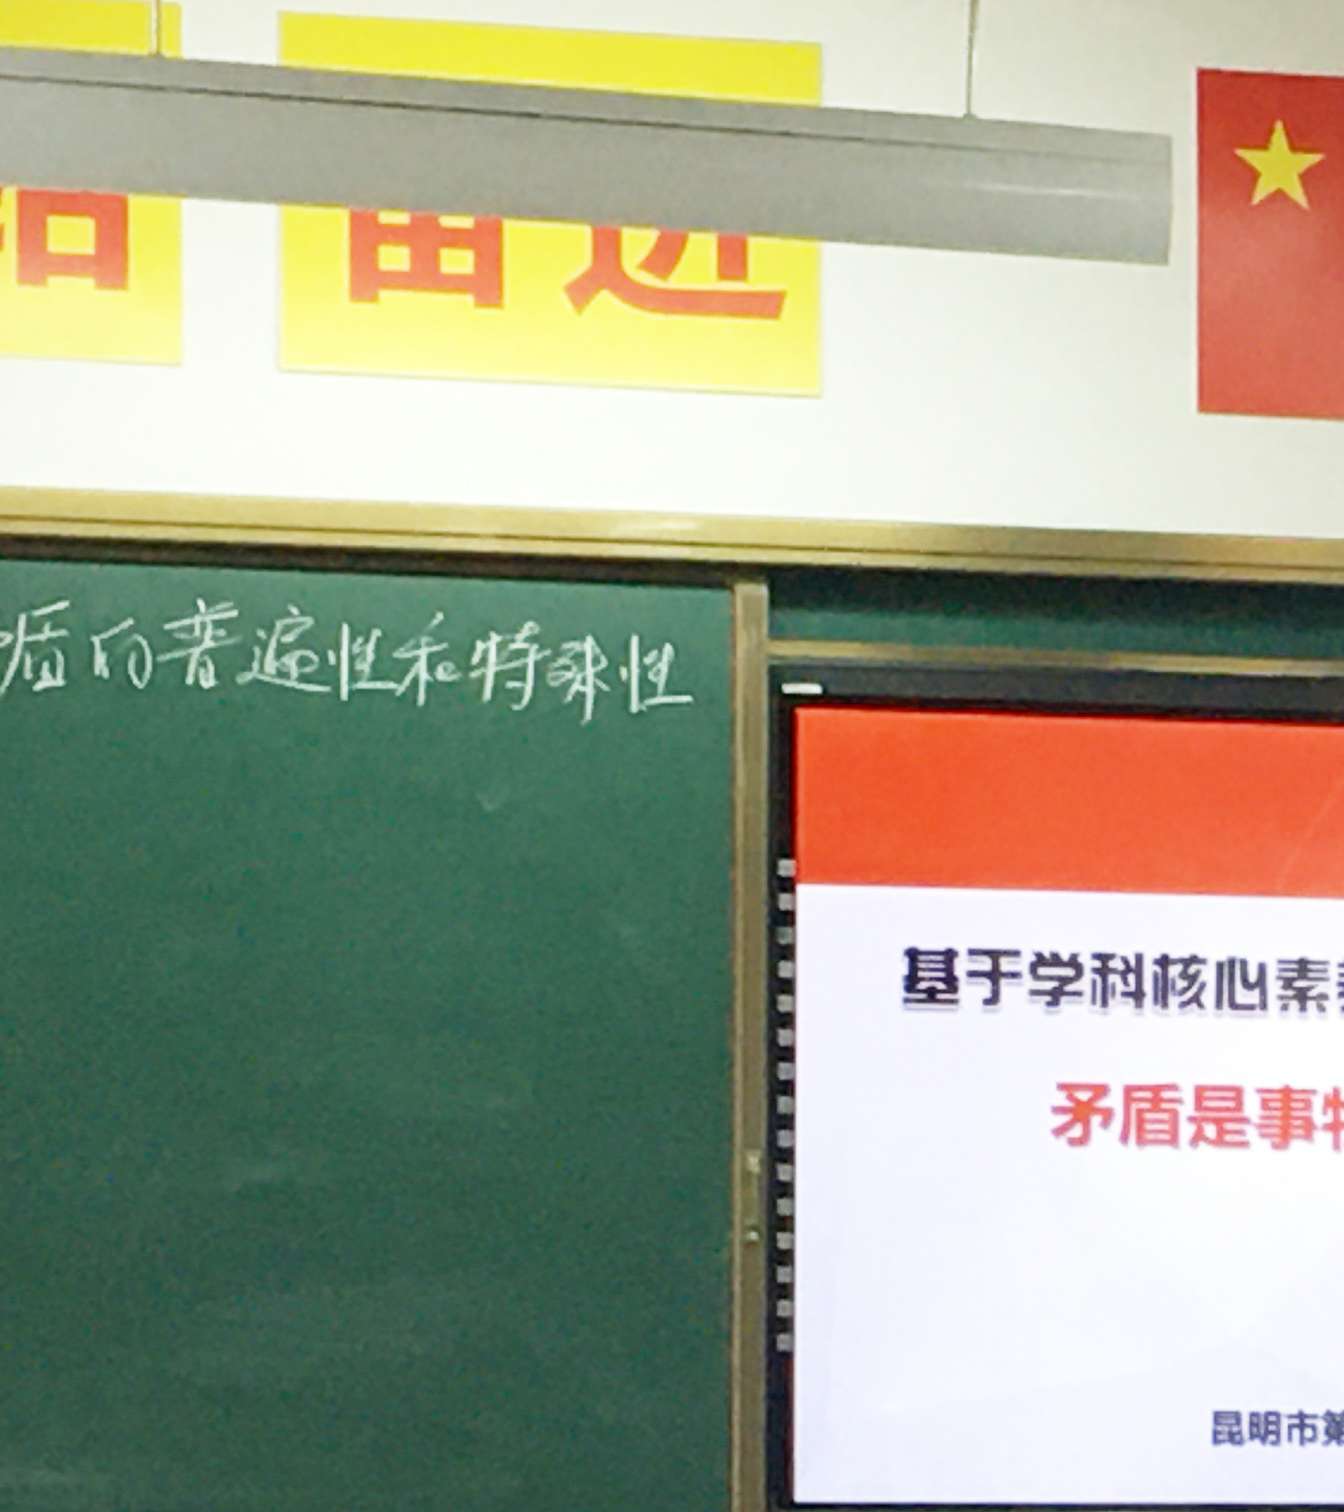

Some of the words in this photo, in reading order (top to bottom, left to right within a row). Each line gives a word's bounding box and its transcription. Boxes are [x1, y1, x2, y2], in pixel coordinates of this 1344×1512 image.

[0, 597, 694, 724] 盾的普遍性和特殊性
